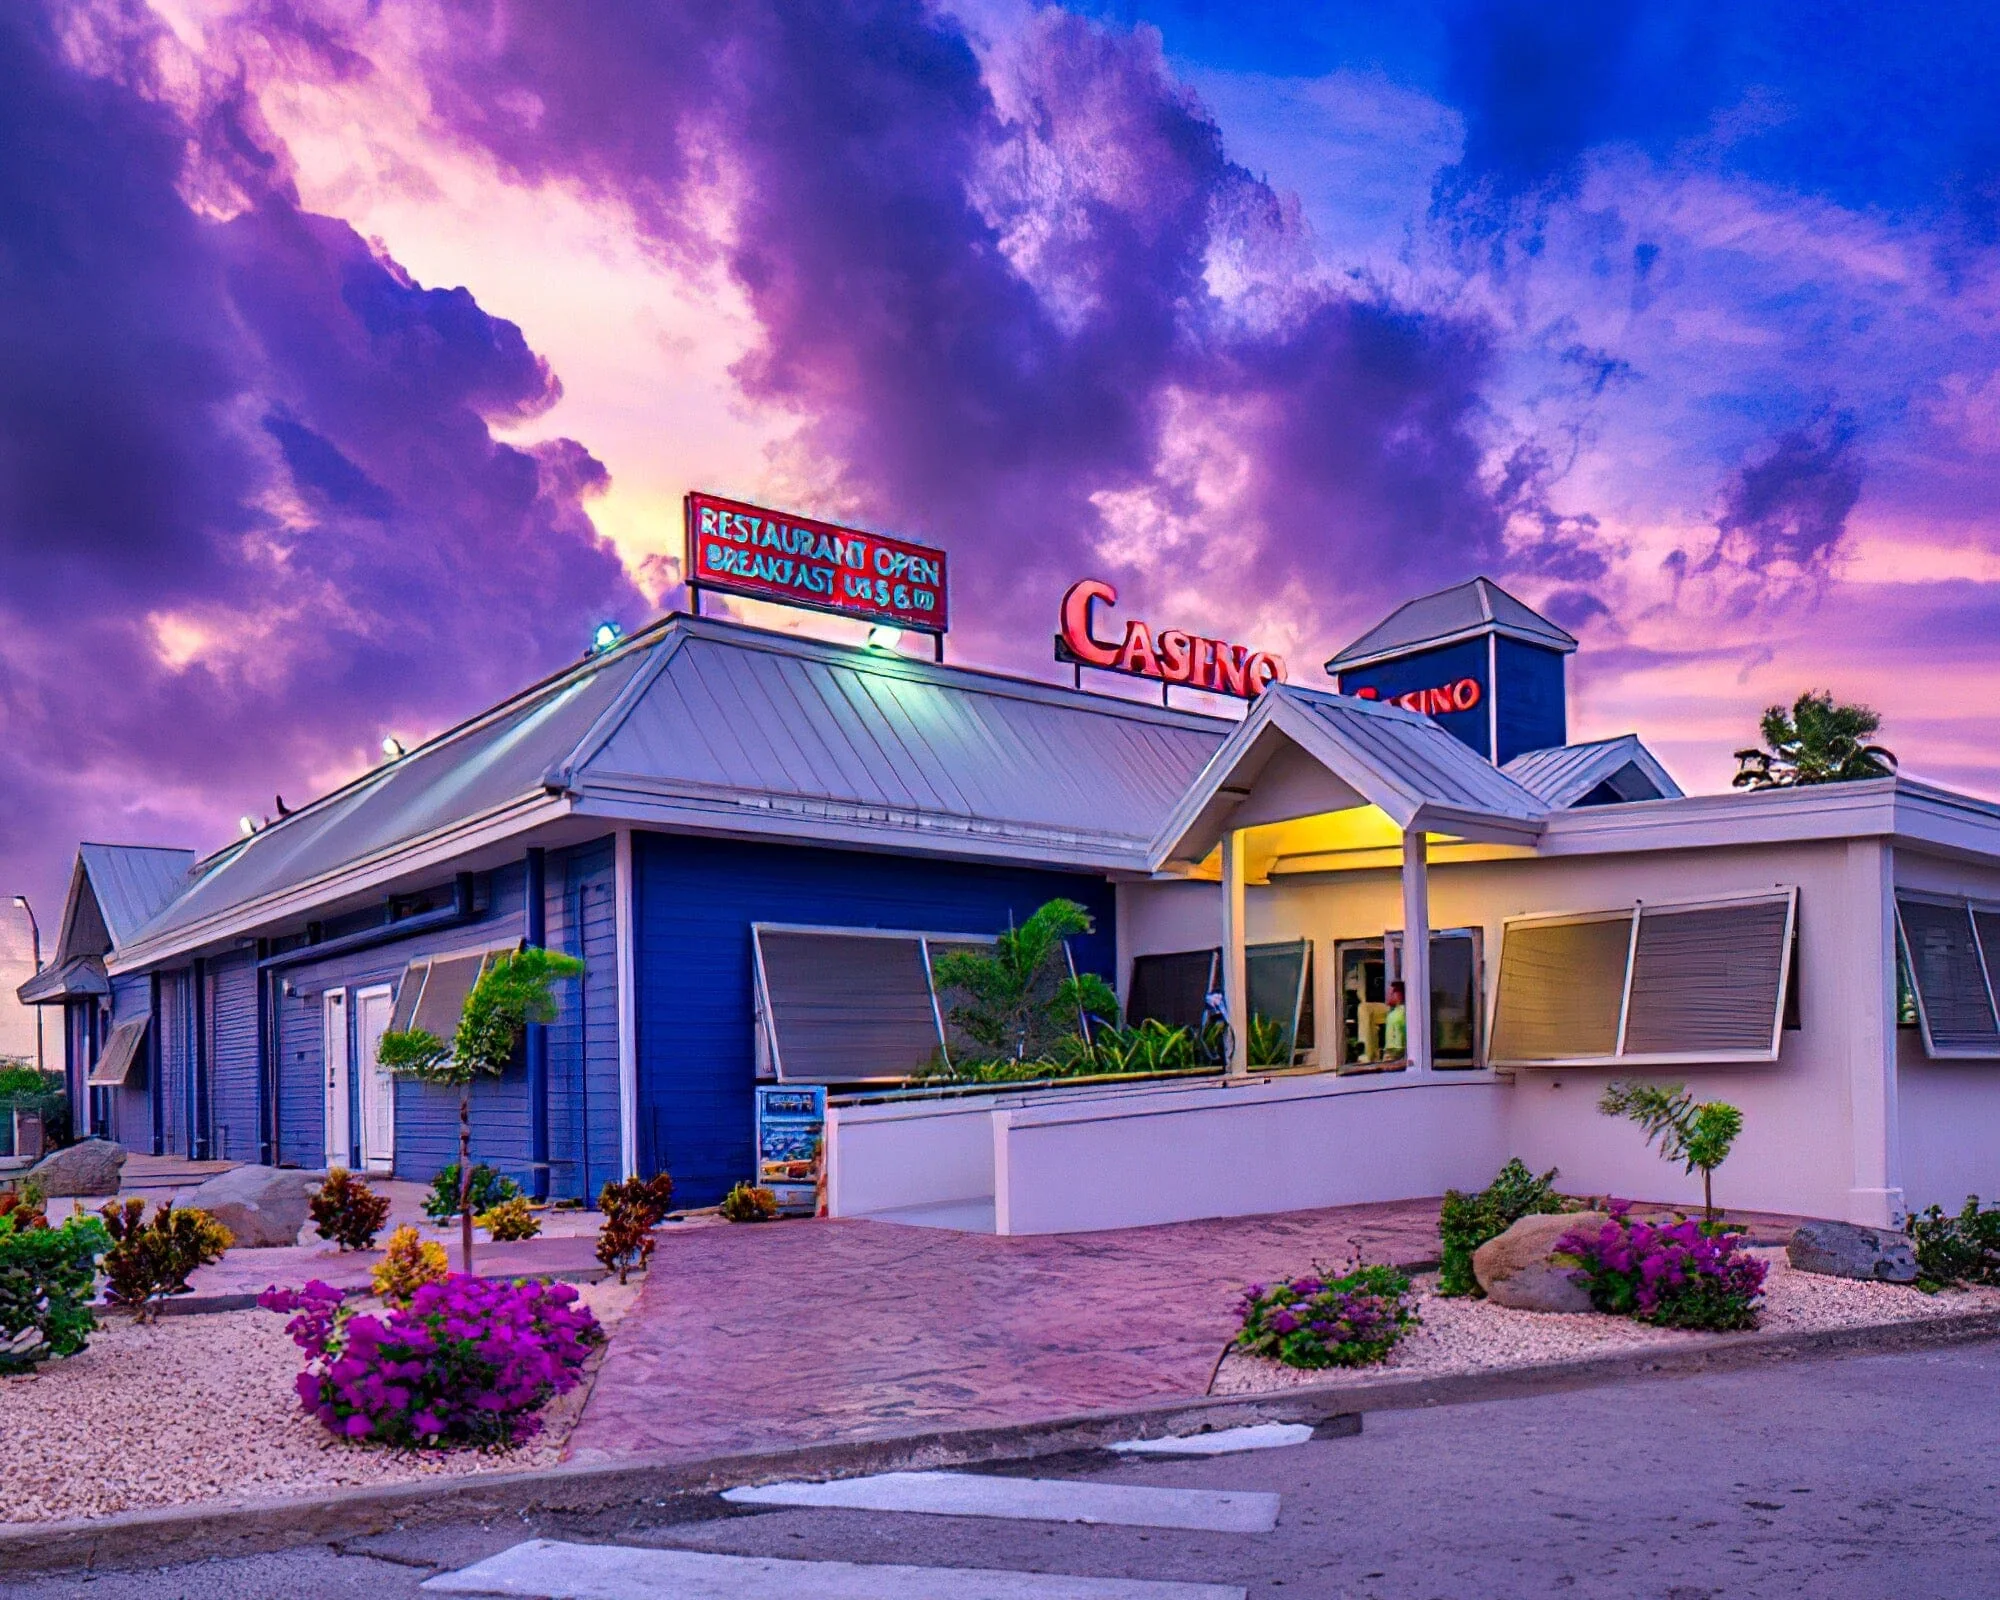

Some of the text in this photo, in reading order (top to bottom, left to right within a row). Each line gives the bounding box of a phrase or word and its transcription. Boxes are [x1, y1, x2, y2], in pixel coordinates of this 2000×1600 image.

[699, 507, 940, 587] RESTAURANT OPEN
[706, 543, 836, 595] BREAKFAST
[1060, 579, 1288, 696] CASINO
